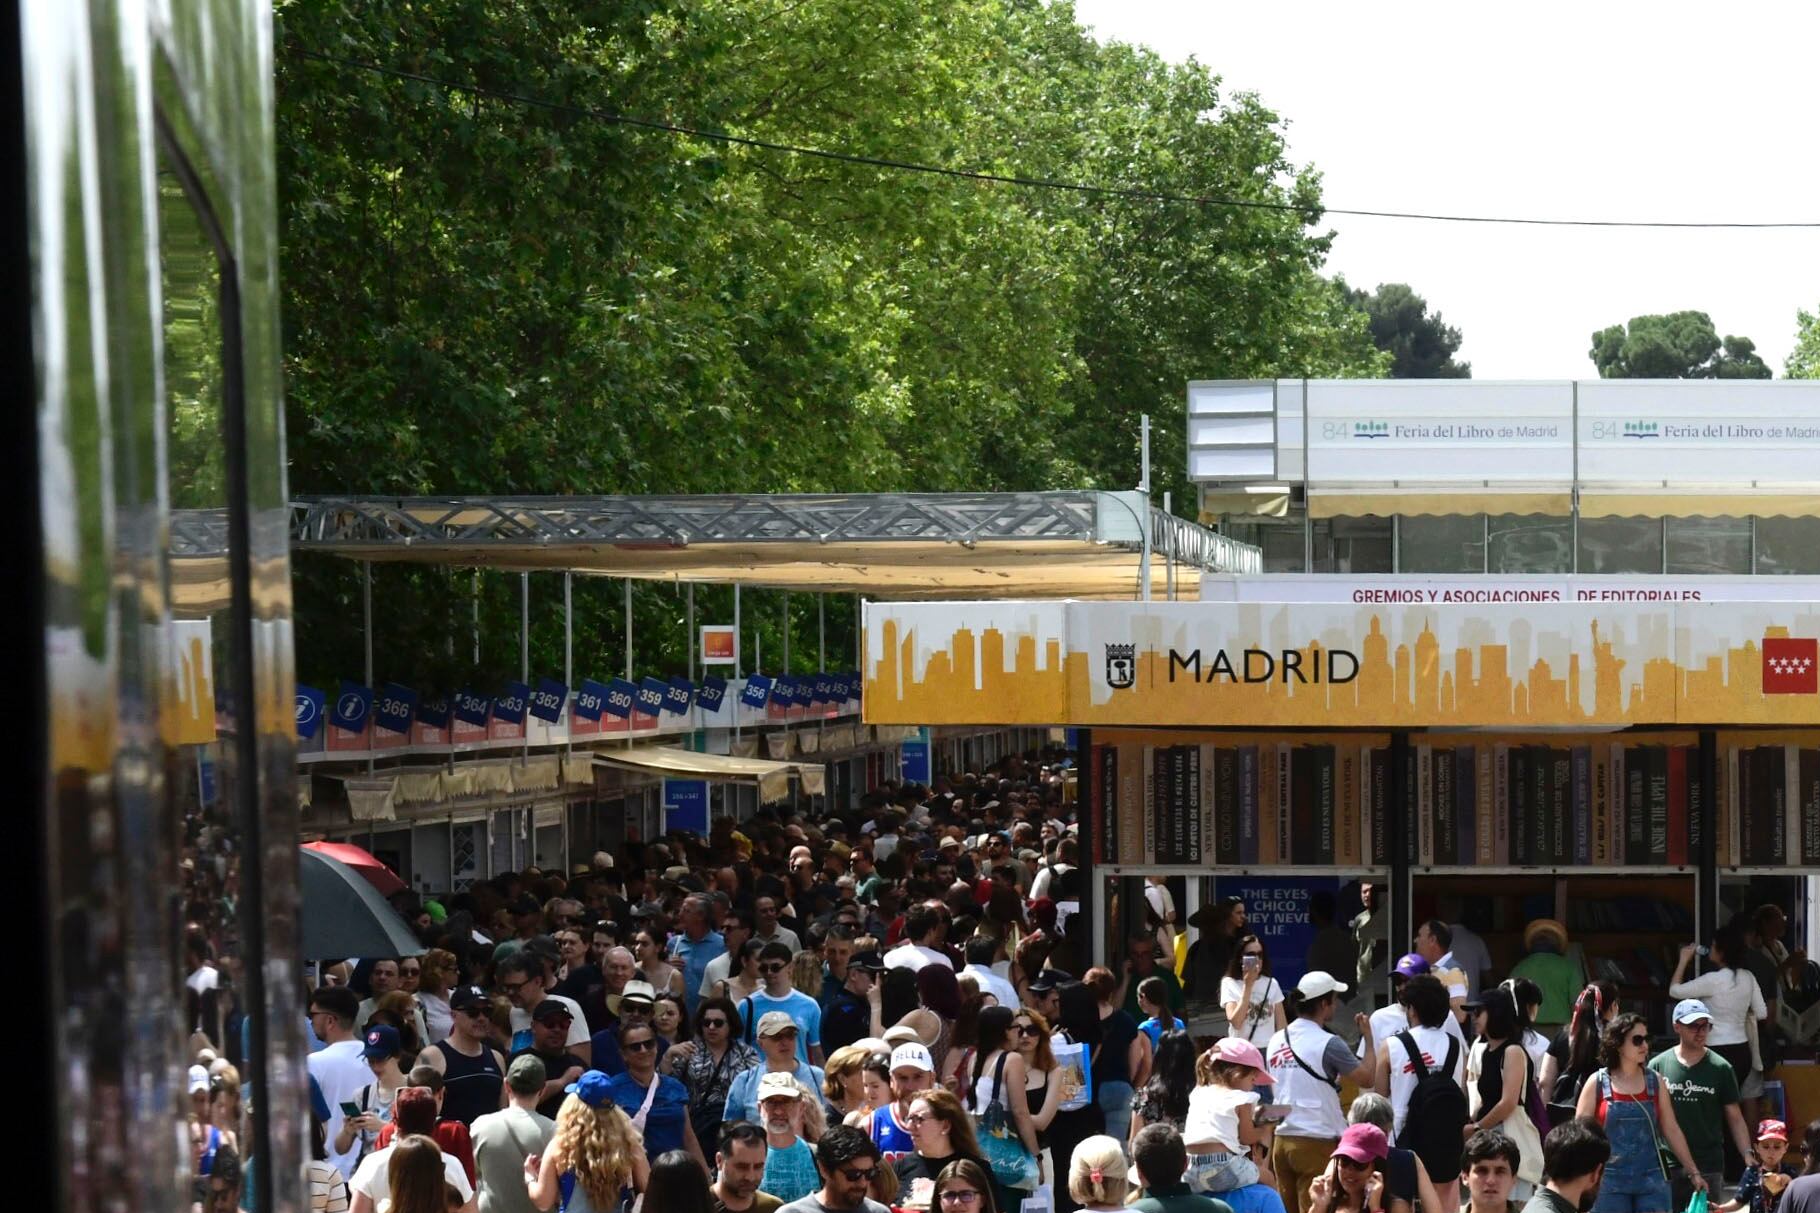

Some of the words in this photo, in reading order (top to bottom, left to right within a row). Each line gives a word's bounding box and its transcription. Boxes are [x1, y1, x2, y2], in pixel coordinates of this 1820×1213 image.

[1322, 422, 1349, 440] 84
[1395, 425, 1429, 439] Feria
[1432, 425, 1454, 439] del
[1458, 425, 1494, 439] Libro
[1497, 426, 1513, 438] de
[1516, 425, 1558, 438] Madrid
[1592, 421, 1619, 440] 84
[1664, 425, 1699, 439] Feria
[1702, 425, 1724, 439] del
[1727, 425, 1763, 439] Libro
[1767, 427, 1782, 439] de
[1353, 589, 1423, 601] GREMIOS
[1427, 589, 1439, 601] Y
[1443, 589, 1560, 601] ASOCIACIONES
[1577, 590, 1597, 601] DE
[1602, 590, 1701, 601] EDITORIALES
[1169, 649, 1360, 684] MADRID
[639, 689, 662, 705] 359
[667, 687, 689, 703] 358
[701, 686, 722, 701] 357
[746, 683, 766, 700] 356
[775, 682, 794, 697] 356
[382, 698, 409, 718] 366
[424, 699, 447, 713] 65
[462, 696, 486, 715] 364
[535, 691, 560, 710] 362
[579, 693, 601, 710] 361
[608, 691, 631, 708] 360
[1189, 773, 1198, 807] CENTRAL
[1650, 776, 1666, 802] APPLE
[1690, 783, 1700, 810] YORK
[1189, 810, 1198, 819] DE
[1650, 806, 1666, 822] THE
[1189, 821, 1198, 846] PATOS
[1690, 812, 1700, 846] NUEVA
[1650, 826, 1666, 853] INSIDE
[1241, 888, 1270, 899] THE
[1253, 900, 1300, 912] CHICO.
[1245, 912, 1270, 923] HEY
[1274, 912, 1310, 923] NEVE
[1682, 1079, 1715, 1097] Jeans
